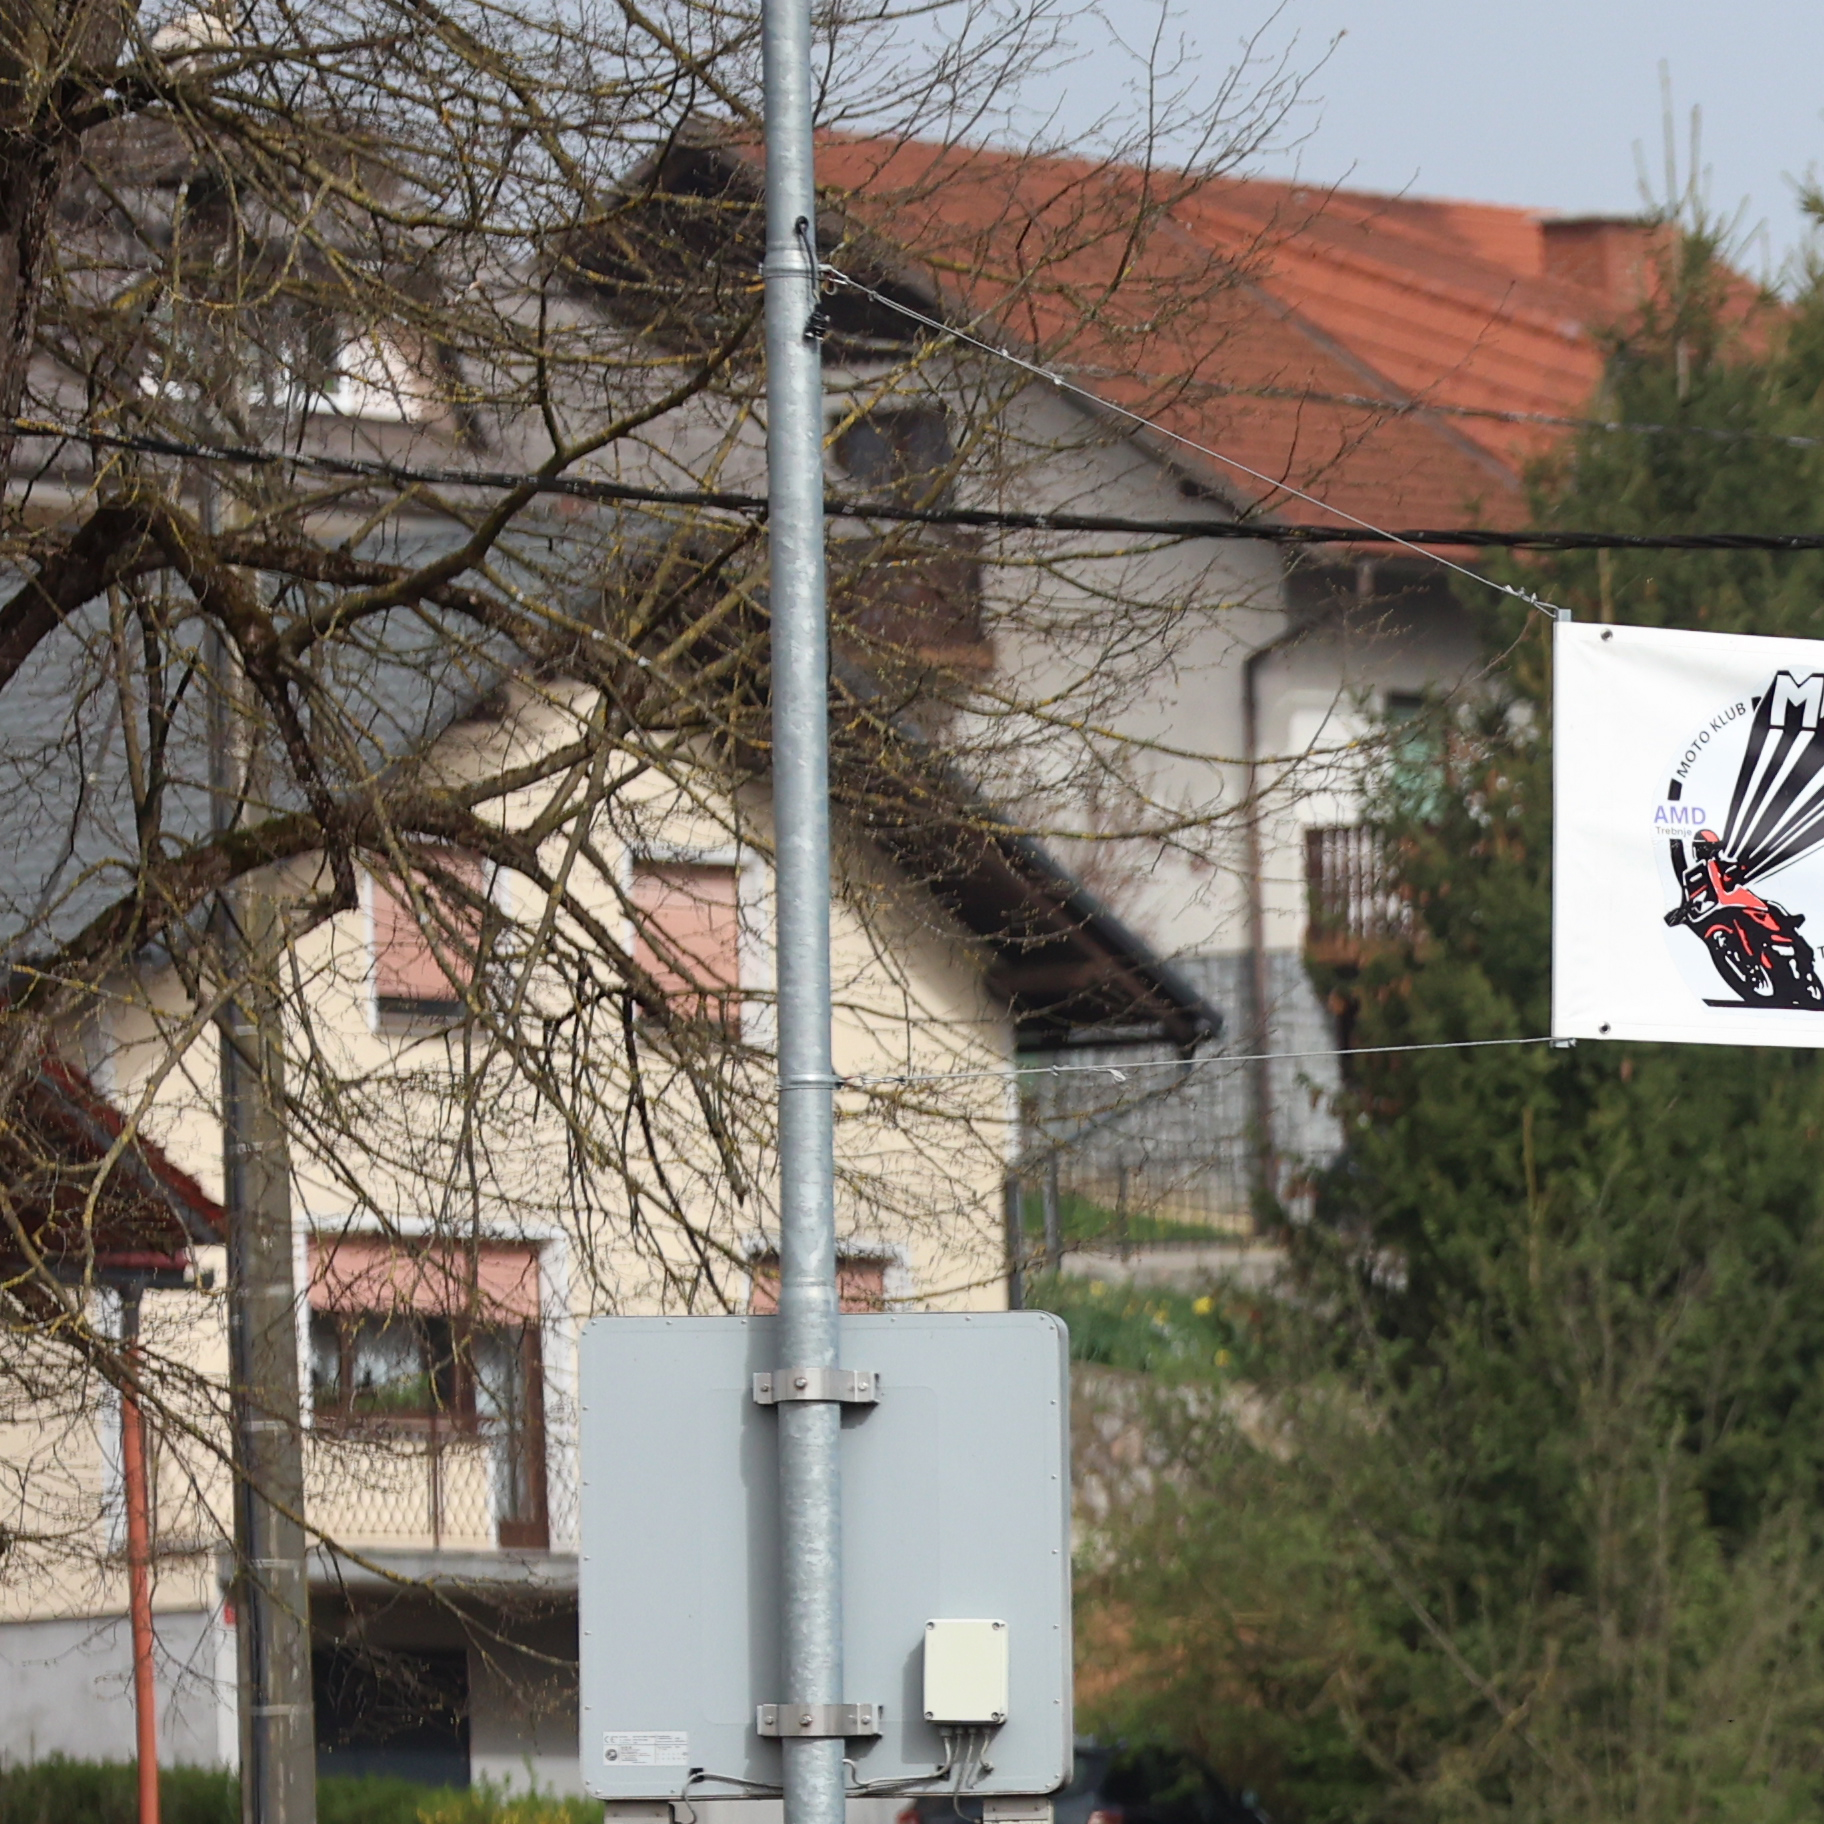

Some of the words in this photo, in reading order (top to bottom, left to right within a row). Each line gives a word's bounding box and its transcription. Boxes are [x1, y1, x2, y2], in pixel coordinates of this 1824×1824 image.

[1676, 730, 1710, 778] MOTO
[1709, 702, 1746, 732] KLUB
[1653, 805, 1706, 825] AMD
[1655, 826, 1693, 838] Trebnje
